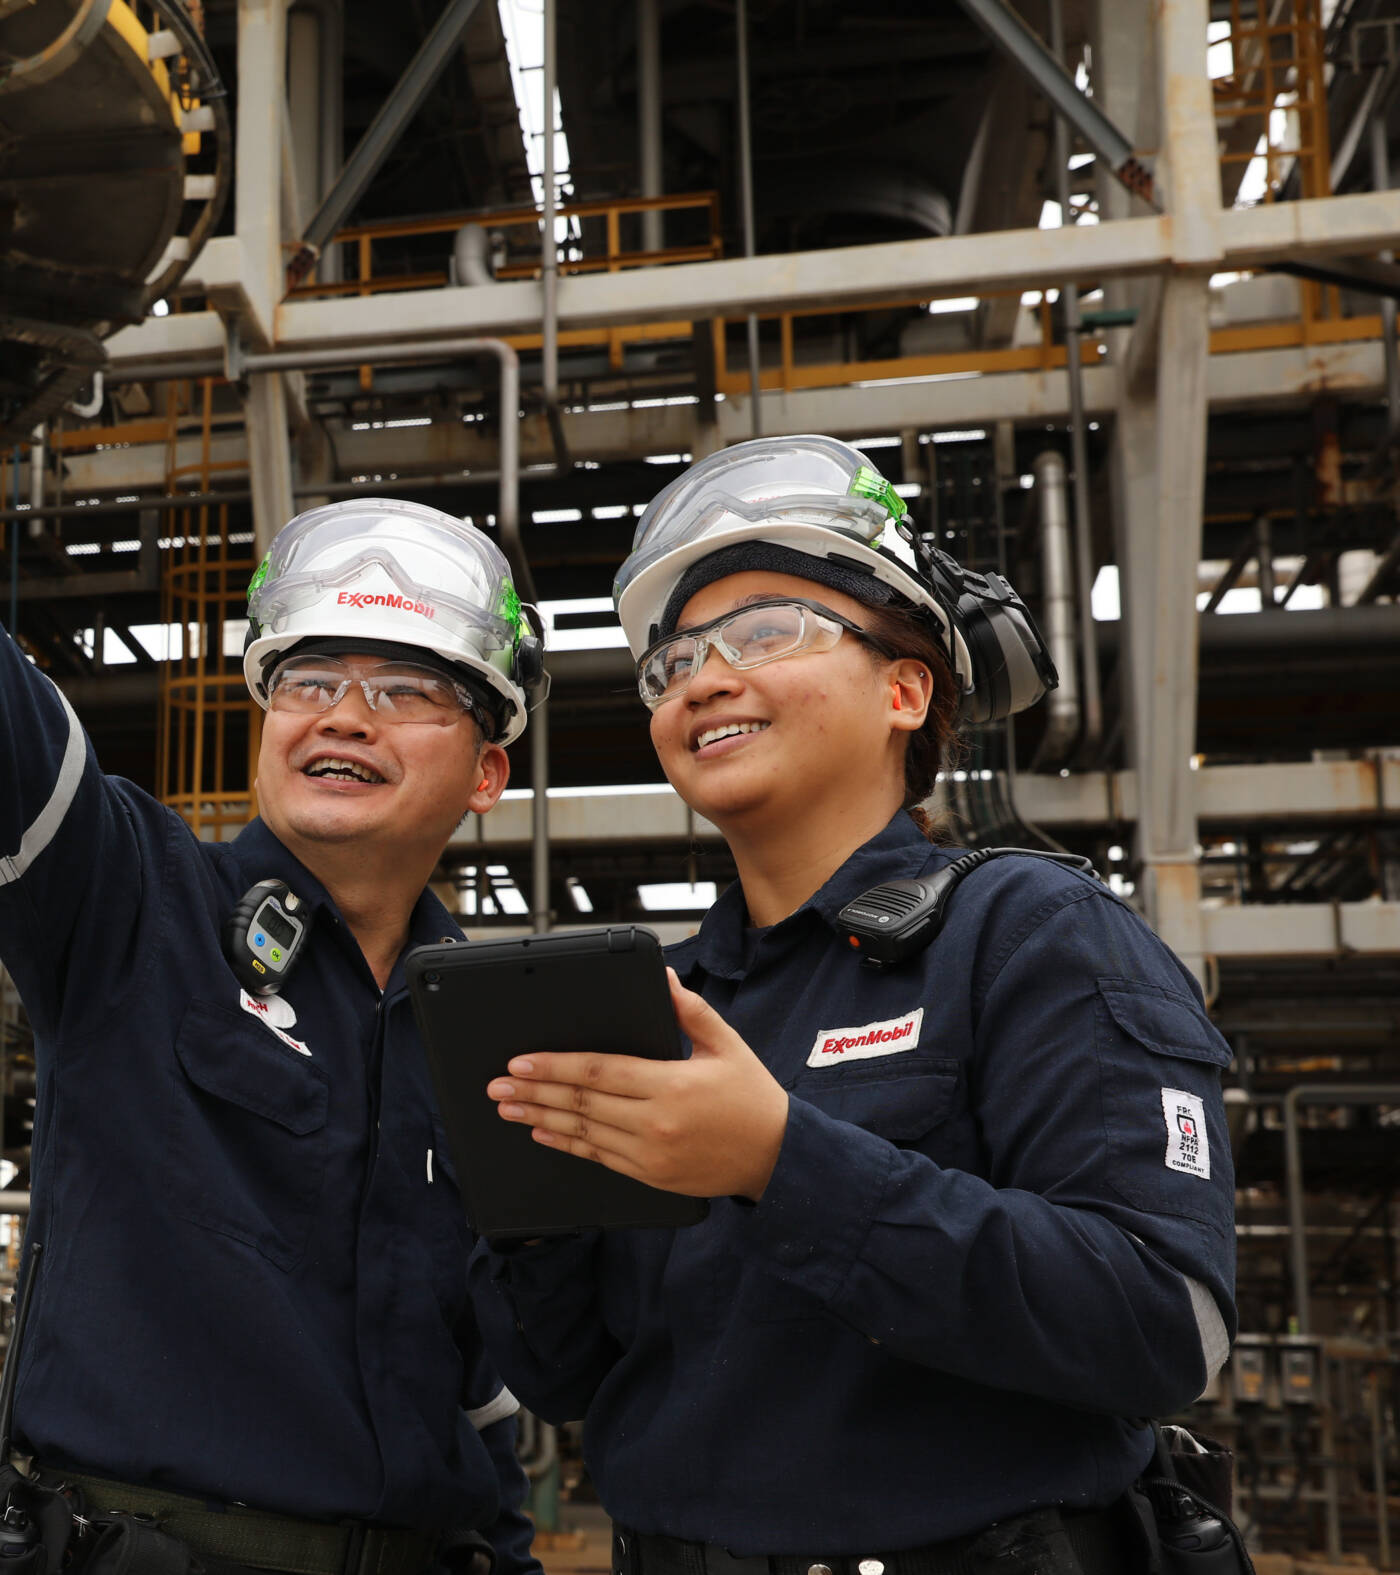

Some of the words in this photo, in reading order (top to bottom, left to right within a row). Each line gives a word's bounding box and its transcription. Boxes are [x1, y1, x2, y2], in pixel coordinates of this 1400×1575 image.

[337, 591, 435, 619] ExxonMobil
[821, 1021, 914, 1054] ExxonMobil
[1179, 1142, 1200, 1155] 2112
[1181, 1152, 1197, 1164] 70E
[1172, 1160, 1205, 1174] COMPLIANT
